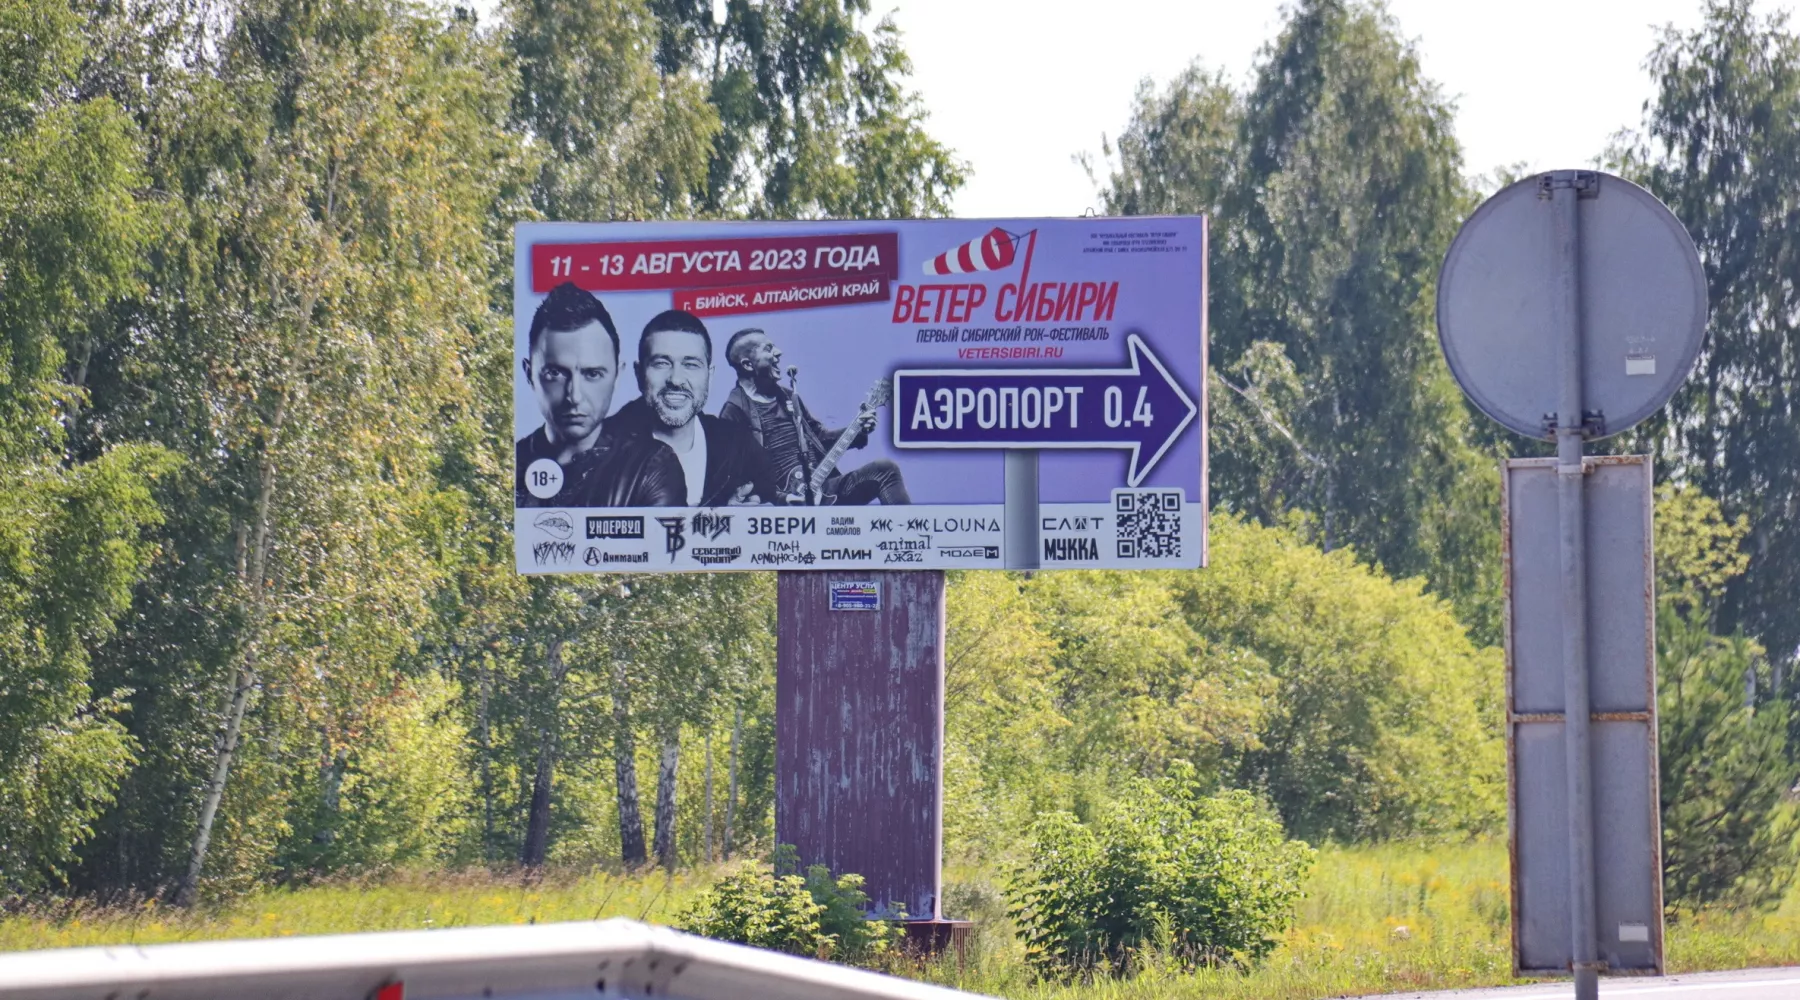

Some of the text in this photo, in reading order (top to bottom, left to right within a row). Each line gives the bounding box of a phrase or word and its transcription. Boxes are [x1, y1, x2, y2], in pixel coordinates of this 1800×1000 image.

[550, 255, 572, 276] 11
[599, 254, 624, 276] 13
[631, 249, 741, 275] АВГУСТА
[749, 247, 807, 271] 2023
[814, 245, 881, 271] ГОДА
[696, 293, 749, 311] БИЙСК,
[753, 283, 839, 304] АЛТАЙСКИЙ
[842, 278, 880, 296] КРАЙ
[892, 281, 1119, 324] ВЕТЕР СИБИРИ
[916, 325, 1110, 343] ПЕРВЫЙ СИБИРСКИЙ РОК-ФЕСТИВАЛЬ
[957, 347, 1064, 360] VETERSIBIRI.RU
[911, 386, 1154, 430] АЭРОПОРТ 0.4
[530, 470, 560, 488] 18+
[588, 519, 641, 535] УНДЕРВУД
[691, 509, 736, 542] АРИЯ
[747, 516, 816, 535] ЗВЕРИ
[830, 516, 855, 526] ВАДИМ
[933, 517, 1000, 533] LOUNA
[826, 525, 861, 537] САМОЙЛОВ
[767, 539, 799, 551] ПЛАН
[876, 533, 934, 551] animal
[1044, 537, 1100, 561] МУККА
[821, 548, 872, 561] СПЛИН
[939, 546, 1000, 560] МОДЕМ
